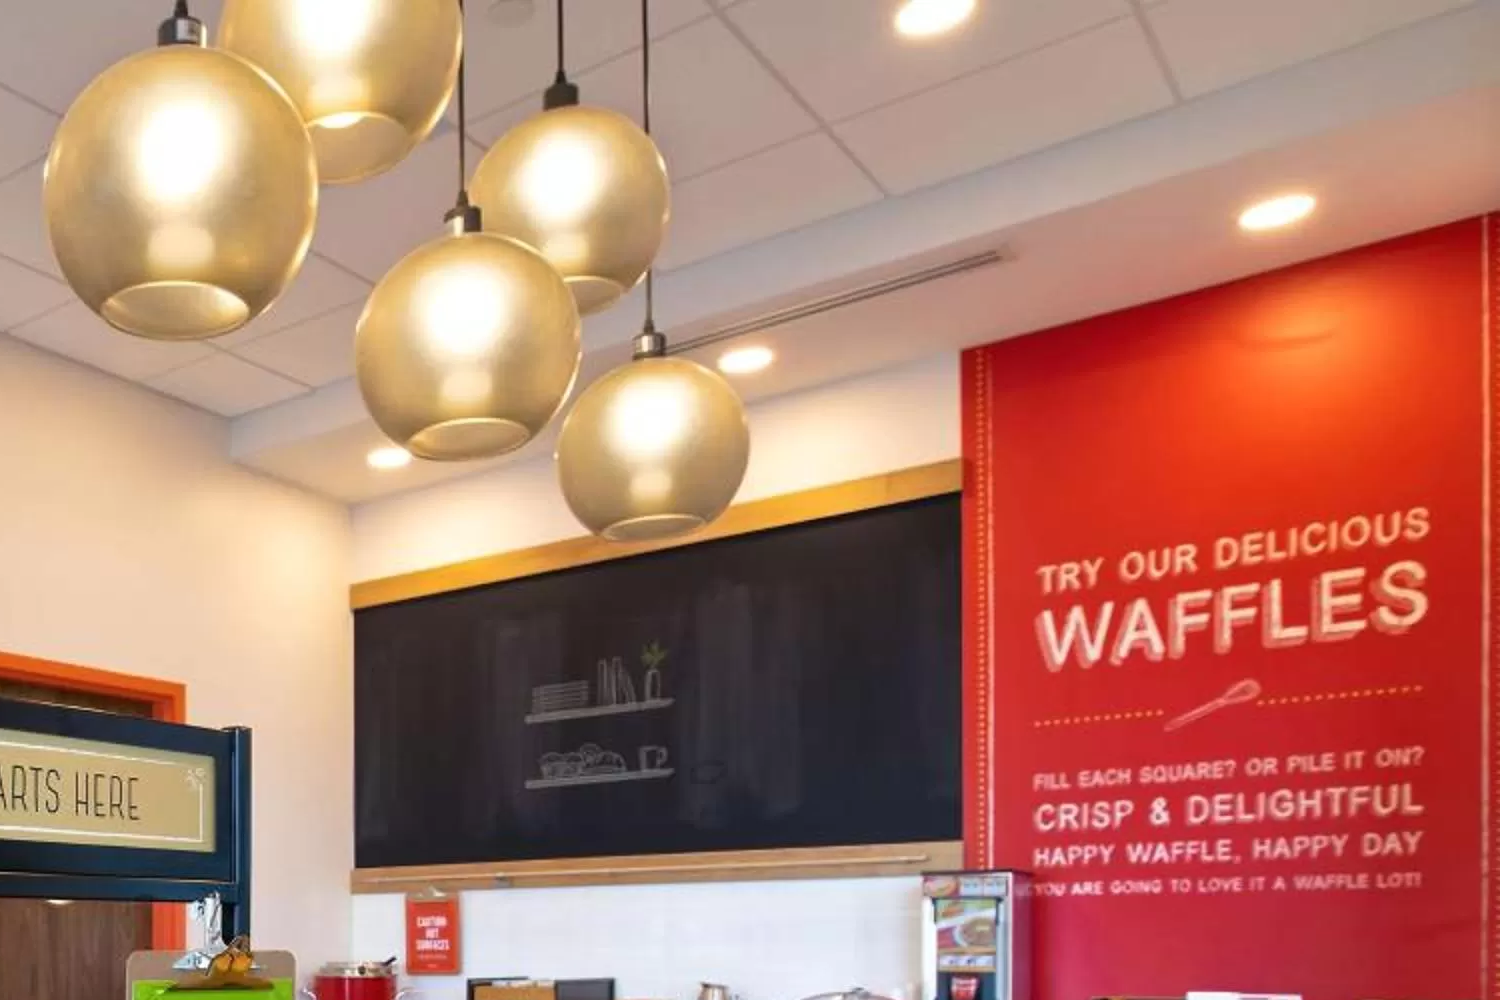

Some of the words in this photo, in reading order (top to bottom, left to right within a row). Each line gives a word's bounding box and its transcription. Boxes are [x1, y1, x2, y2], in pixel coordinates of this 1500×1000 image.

[1036, 555, 1104, 594] TRY
[1119, 543, 1198, 583] OUR
[1212, 506, 1431, 571] DELICIOUS
[1034, 560, 1430, 673] WAFFLES
[1032, 772, 1072, 792] FILL
[1077, 767, 1132, 789] EACH
[1138, 759, 1237, 785] SQUARE?
[1244, 756, 1279, 777] OR
[1286, 751, 1337, 773] PILE
[1343, 749, 1365, 770] IT
[1374, 745, 1426, 768] ON?
[74, 770, 142, 821] HERE
[1034, 799, 1135, 833] CRISP
[1148, 795, 1171, 827] &
[1186, 783, 1425, 826] DELIGHTFUL
[1033, 843, 1116, 869] HAPPY
[1126, 838, 1242, 866] WAFFLE,
[1251, 833, 1350, 861] HAPPY
[1361, 830, 1424, 858] DAY
[1034, 881, 1067, 897] YOU
[1070, 879, 1105, 896] ARE
[1110, 878, 1164, 895] GOING
[1170, 877, 1193, 894] TO
[1198, 875, 1244, 893] LOVE
[1249, 875, 1266, 892] IT
[1272, 875, 1287, 891] A
[1292, 871, 1370, 890] WAFFLE
